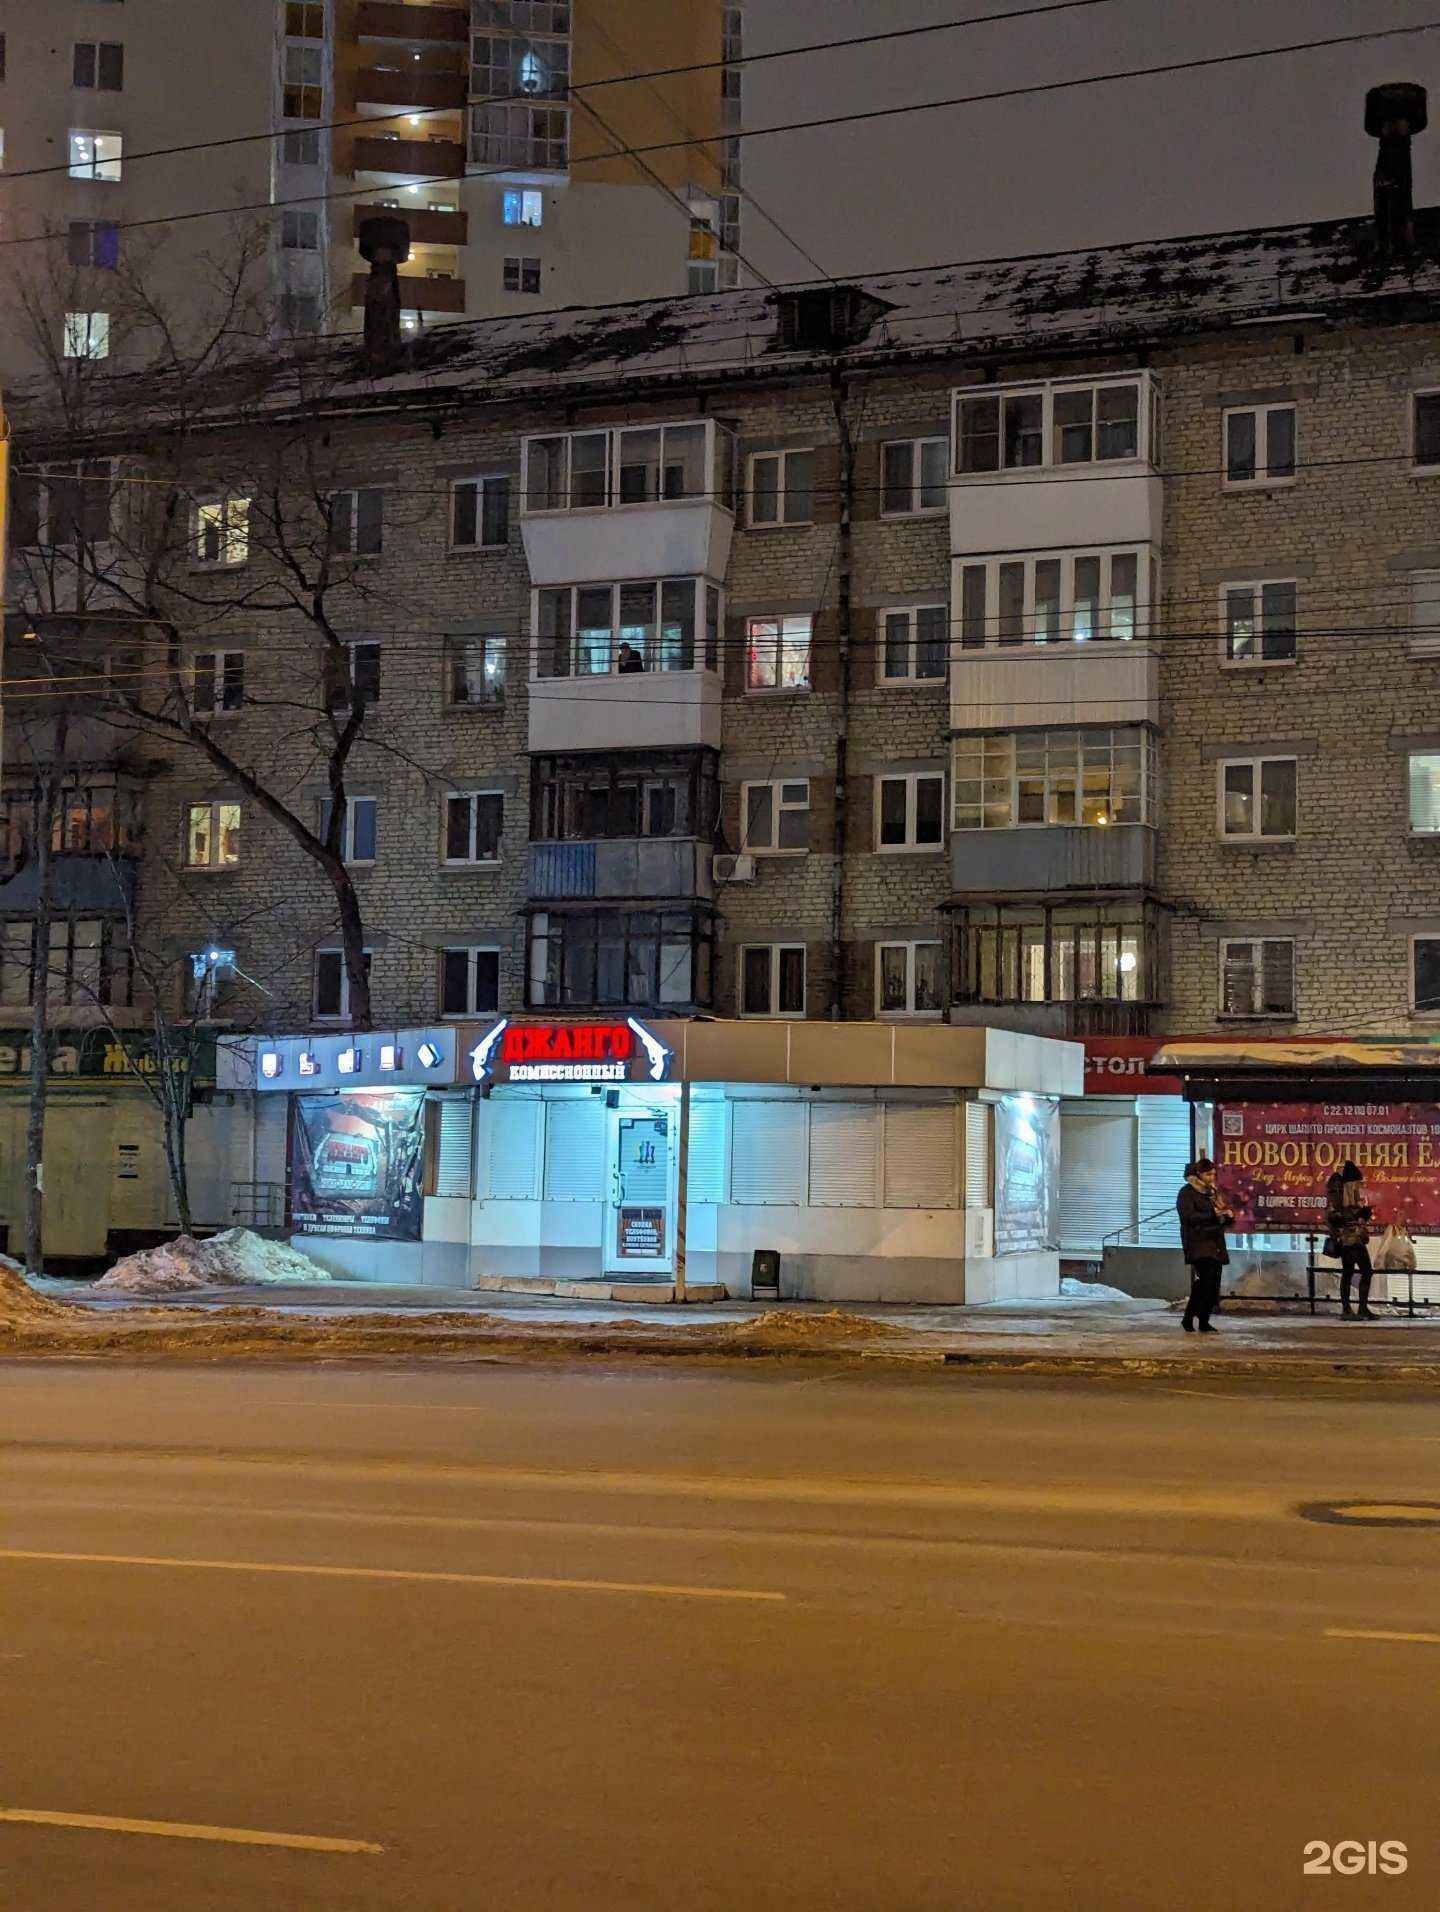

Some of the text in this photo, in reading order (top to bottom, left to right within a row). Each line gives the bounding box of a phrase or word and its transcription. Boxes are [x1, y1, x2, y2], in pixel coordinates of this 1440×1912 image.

[503, 1025, 632, 1063] ДЖАНГО
[509, 1061, 625, 1080] КОМИССИОННЫЙ
[1265, 1124, 1288, 1134] ЦИРК
[1324, 1124, 1367, 1135] ПРОСПЕКТ
[1367, 1124, 1428, 1135] КОСМОНАВТОВ
[1223, 1141, 1409, 1171] НОВОГОДНЯЯ
[1258, 1196, 1265, 1207] В
[1266, 1196, 1296, 1208] ЦИРКЕ
